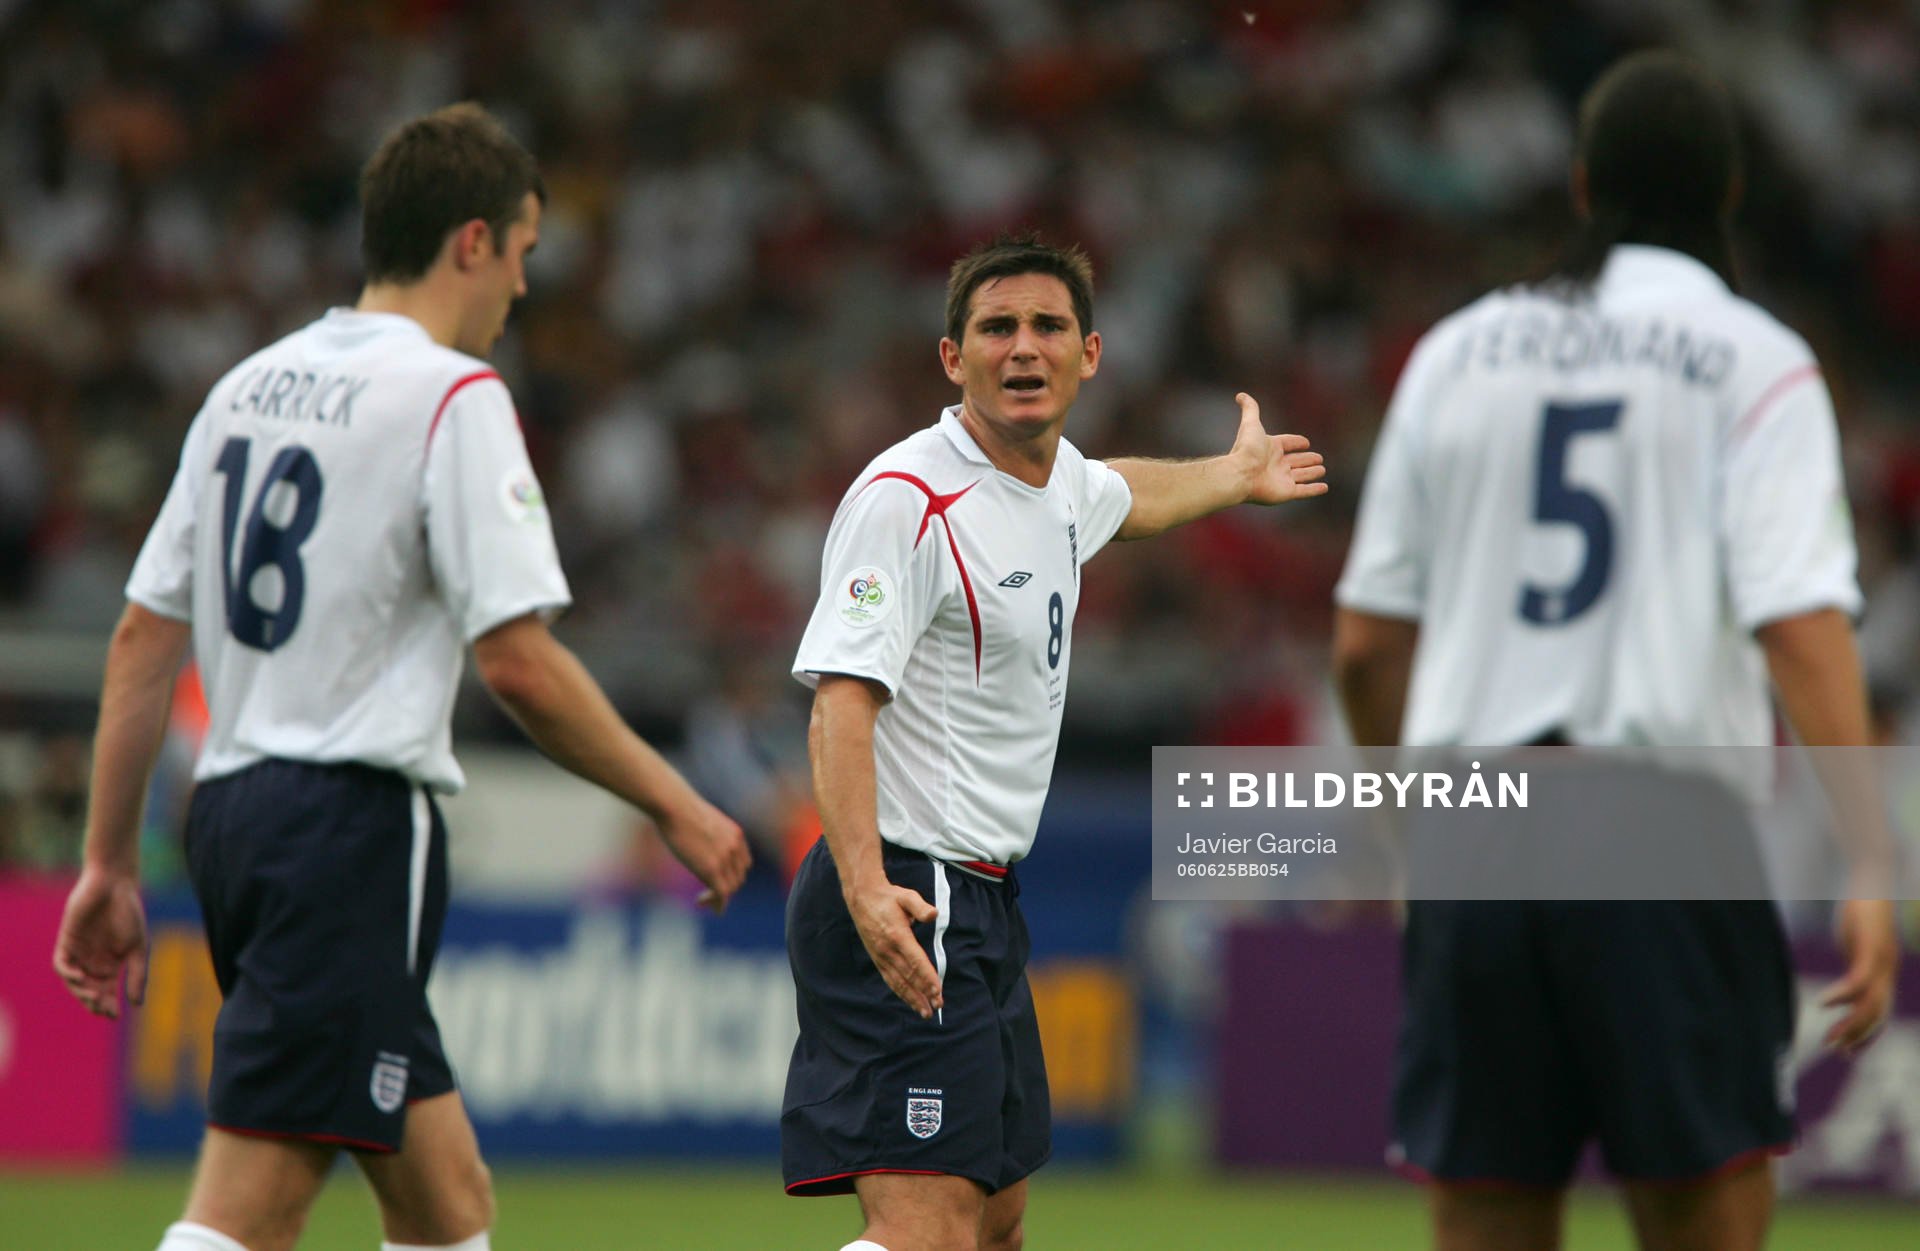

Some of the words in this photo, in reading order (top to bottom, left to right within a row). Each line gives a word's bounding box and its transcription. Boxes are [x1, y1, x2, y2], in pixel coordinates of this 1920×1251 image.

[230, 367, 370, 427] CARRICK
[214, 436, 323, 652] 18
[1515, 398, 1627, 628] 5
[1048, 591, 1063, 670] 8
[908, 1087, 943, 1095] ENGLAND
